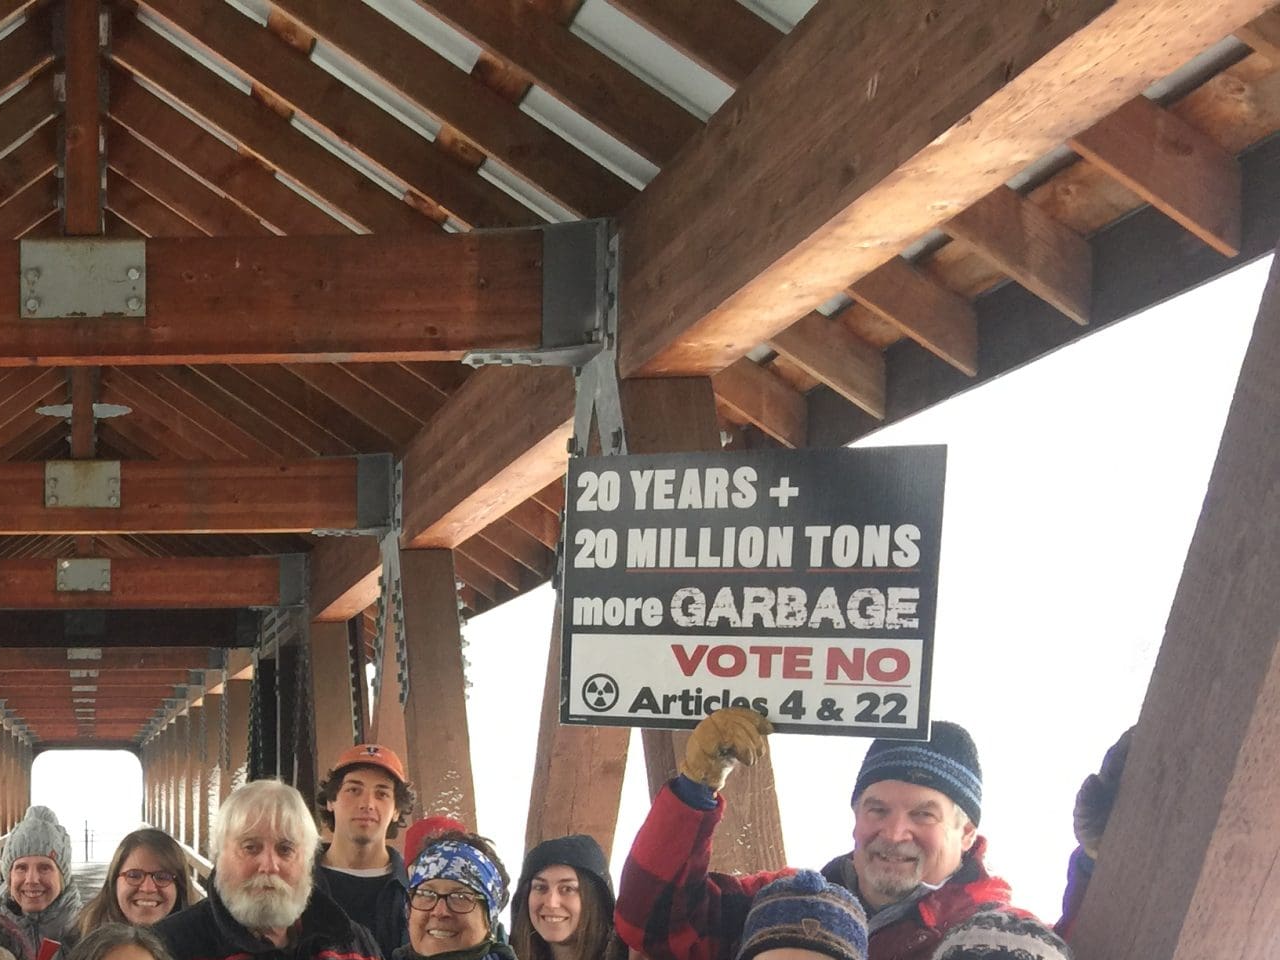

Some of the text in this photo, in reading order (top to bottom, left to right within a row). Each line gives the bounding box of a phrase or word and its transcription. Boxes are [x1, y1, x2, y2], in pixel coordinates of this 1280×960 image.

[576, 465, 799, 511] 20 YEARS +
[573, 524, 921, 569] 20 MILLION TONS
[572, 586, 921, 630] more GARBAGE
[671, 643, 911, 683] VOTE NO
[779, 690, 806, 720] 4
[816, 697, 844, 722] &
[854, 692, 907, 724] 22
